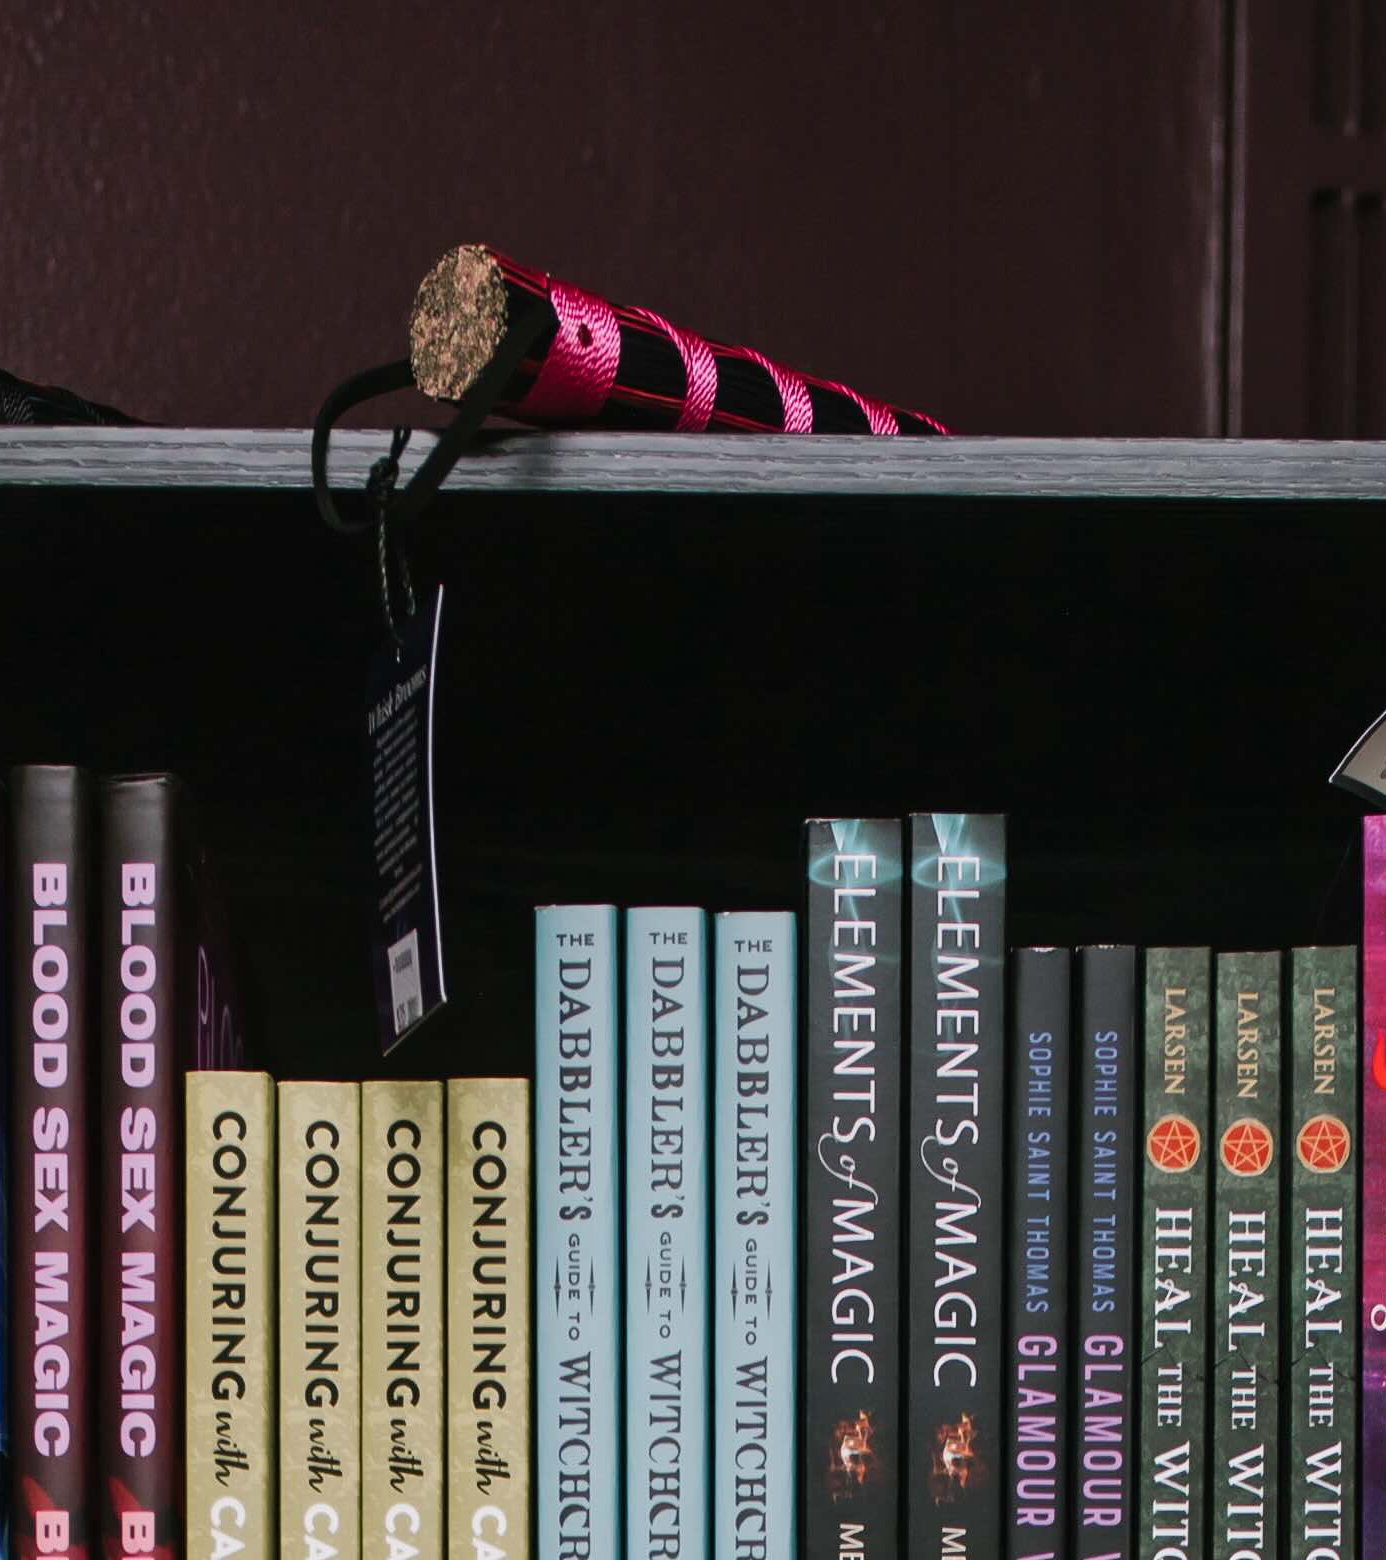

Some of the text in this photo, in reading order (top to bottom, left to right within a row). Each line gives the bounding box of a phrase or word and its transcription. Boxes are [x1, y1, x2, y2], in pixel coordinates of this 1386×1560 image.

[555, 932, 596, 948] THE
[558, 957, 594, 1221] DABBLER'S
[1164, 987, 1186, 1096] LARSEN
[30, 861, 70, 1459] BLOOD SEX MAGIC
[817, 853, 879, 1384] ELEMENTS of MAGIC
[471, 1121, 506, 1412] CONJURING
[568, 1233, 581, 1341] GUIDE TO
[1152, 1207, 1192, 1350] HEAL
[471, 1415, 513, 1492] with
[1083, 1335, 1126, 1529] GLAMOUR
[1158, 1362, 1183, 1428] THE
